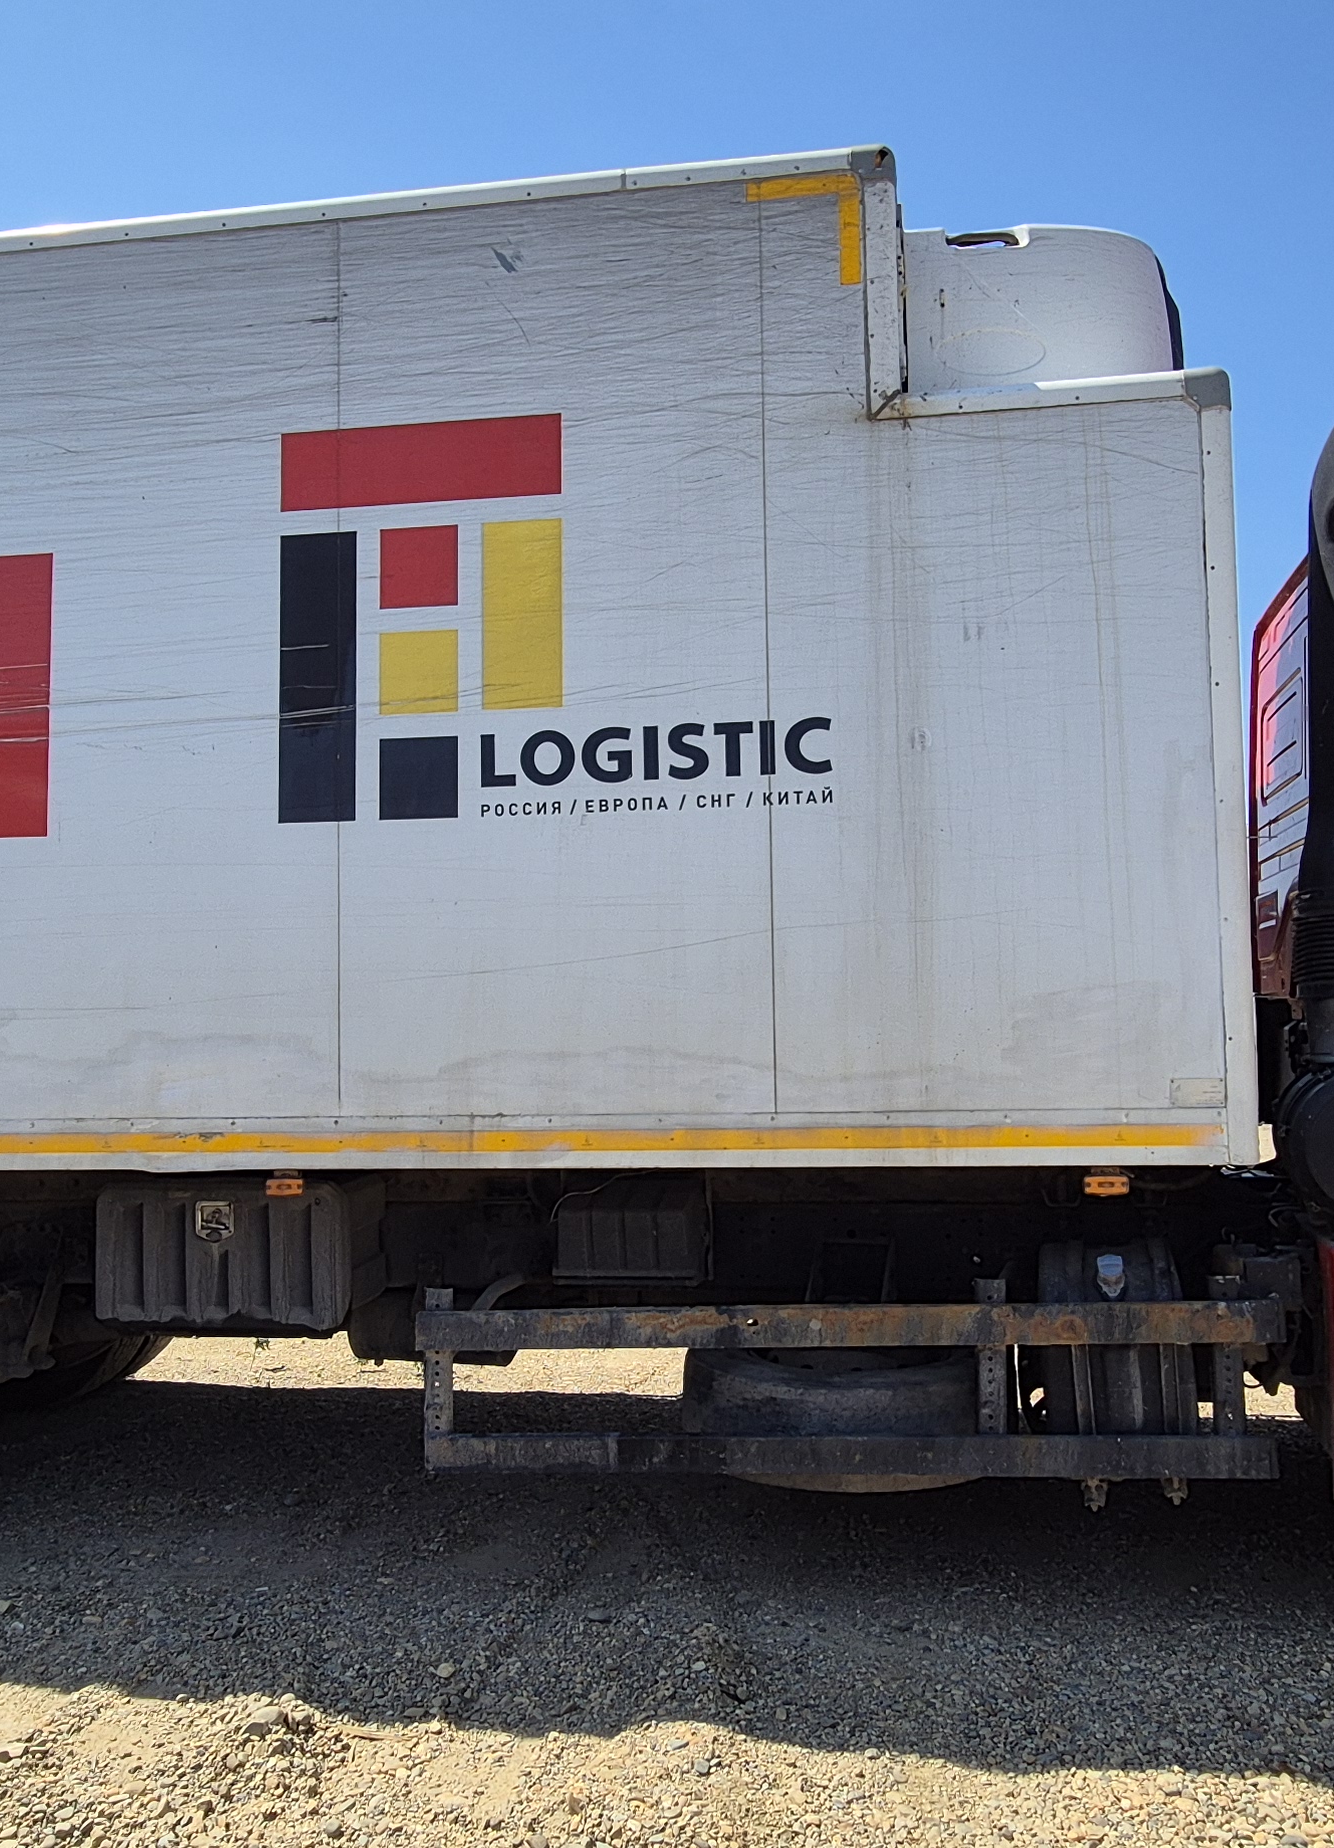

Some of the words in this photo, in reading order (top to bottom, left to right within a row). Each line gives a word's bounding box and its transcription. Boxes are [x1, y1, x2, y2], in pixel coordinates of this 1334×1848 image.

[480, 716, 833, 788] LOGISTIC
[480, 800, 562, 818] РОССИЯ
[585, 795, 669, 814] ЕВРОПА
[696, 793, 737, 809] СНГ
[762, 786, 835, 807] КИТАЙ
